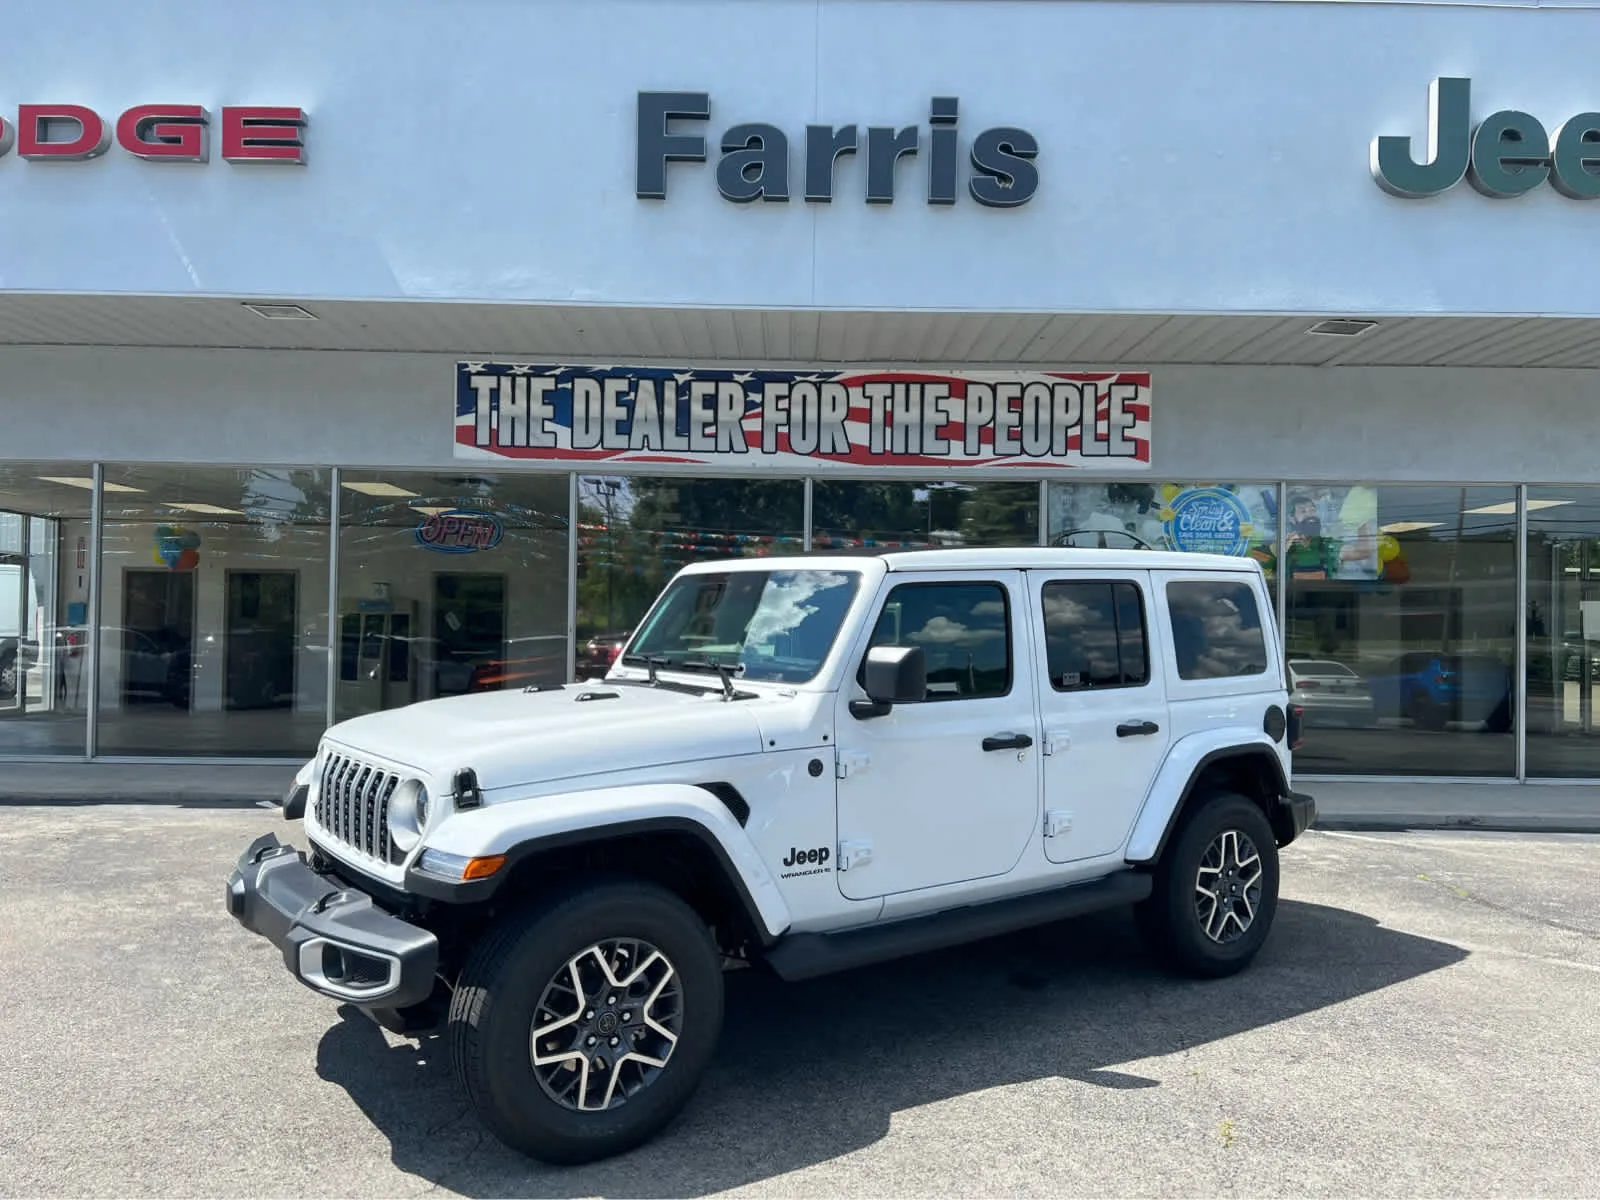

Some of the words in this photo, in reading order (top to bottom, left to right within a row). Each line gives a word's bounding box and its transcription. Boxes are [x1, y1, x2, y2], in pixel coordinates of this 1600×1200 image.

[0, 104, 307, 167] DGE
[636, 91, 1040, 208] Farris
[470, 374, 558, 449] THE
[570, 375, 750, 454] DEALER
[761, 380, 850, 456] FOR
[863, 380, 951, 456] THE
[963, 380, 1139, 457] PEOPLE
[422, 513, 496, 547] OPEN
[783, 847, 830, 867] Jeep
